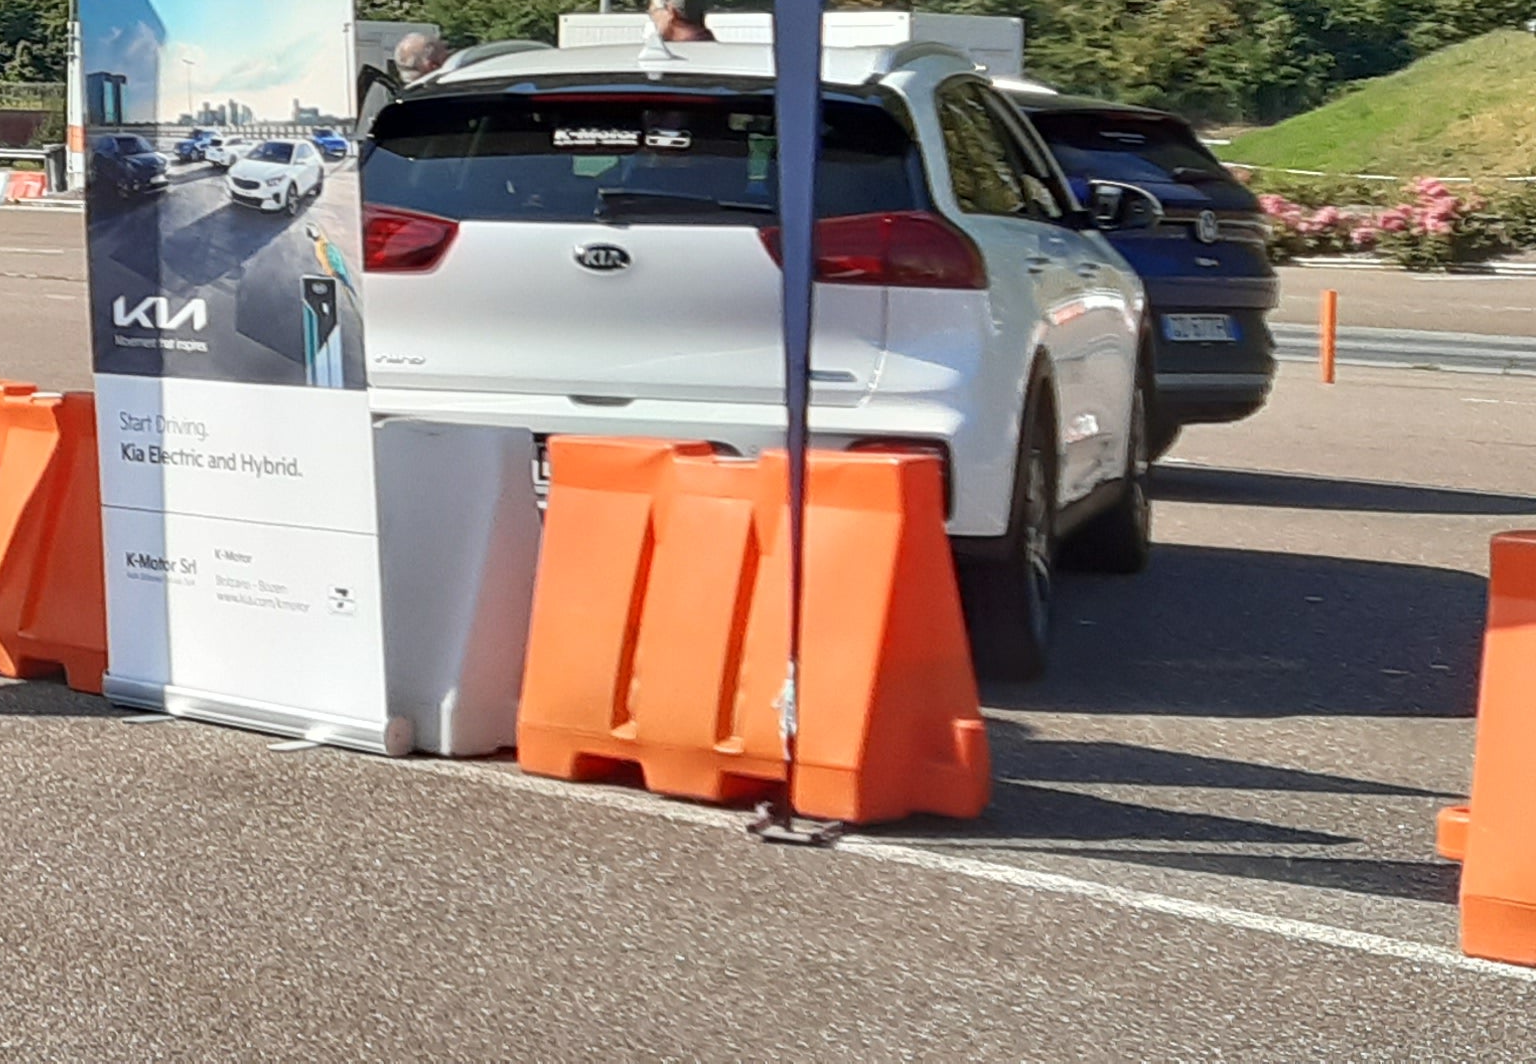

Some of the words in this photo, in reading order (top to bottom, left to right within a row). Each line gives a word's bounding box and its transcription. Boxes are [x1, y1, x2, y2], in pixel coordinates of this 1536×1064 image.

[583, 249, 621, 266] KIA
[119, 411, 152, 432] Start
[156, 415, 209, 441] Driving.
[121, 443, 145, 463] Kia
[149, 446, 204, 468] Electric
[208, 450, 237, 471] and
[241, 454, 303, 478] Hybrid.
[126, 551, 176, 573] K-Motor
